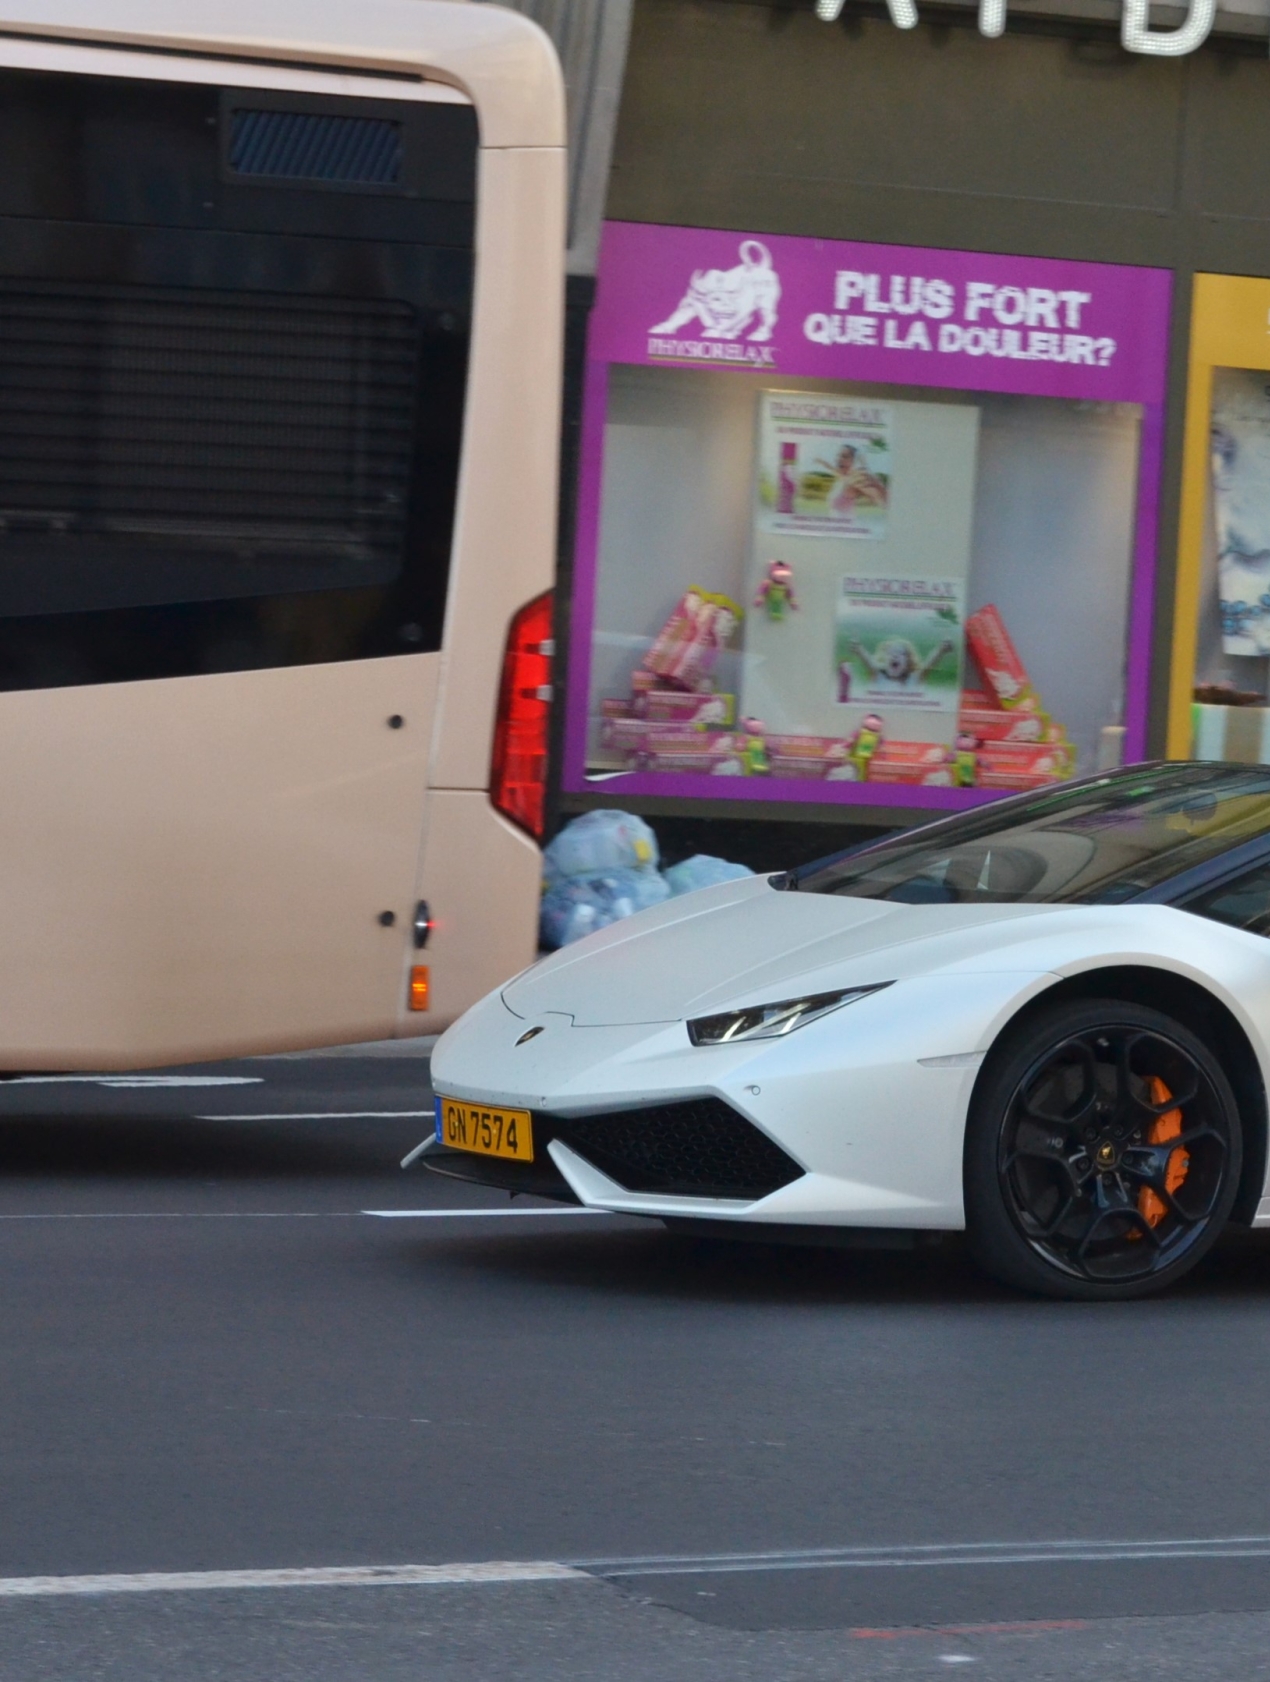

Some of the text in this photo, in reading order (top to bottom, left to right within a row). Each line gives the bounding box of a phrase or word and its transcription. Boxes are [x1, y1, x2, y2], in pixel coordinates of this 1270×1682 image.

[835, 270, 1092, 329] PLUS FORT
[804, 313, 1117, 367] QUE LA DOULEUR?
[448, 1106, 518, 1154] GN 7574
